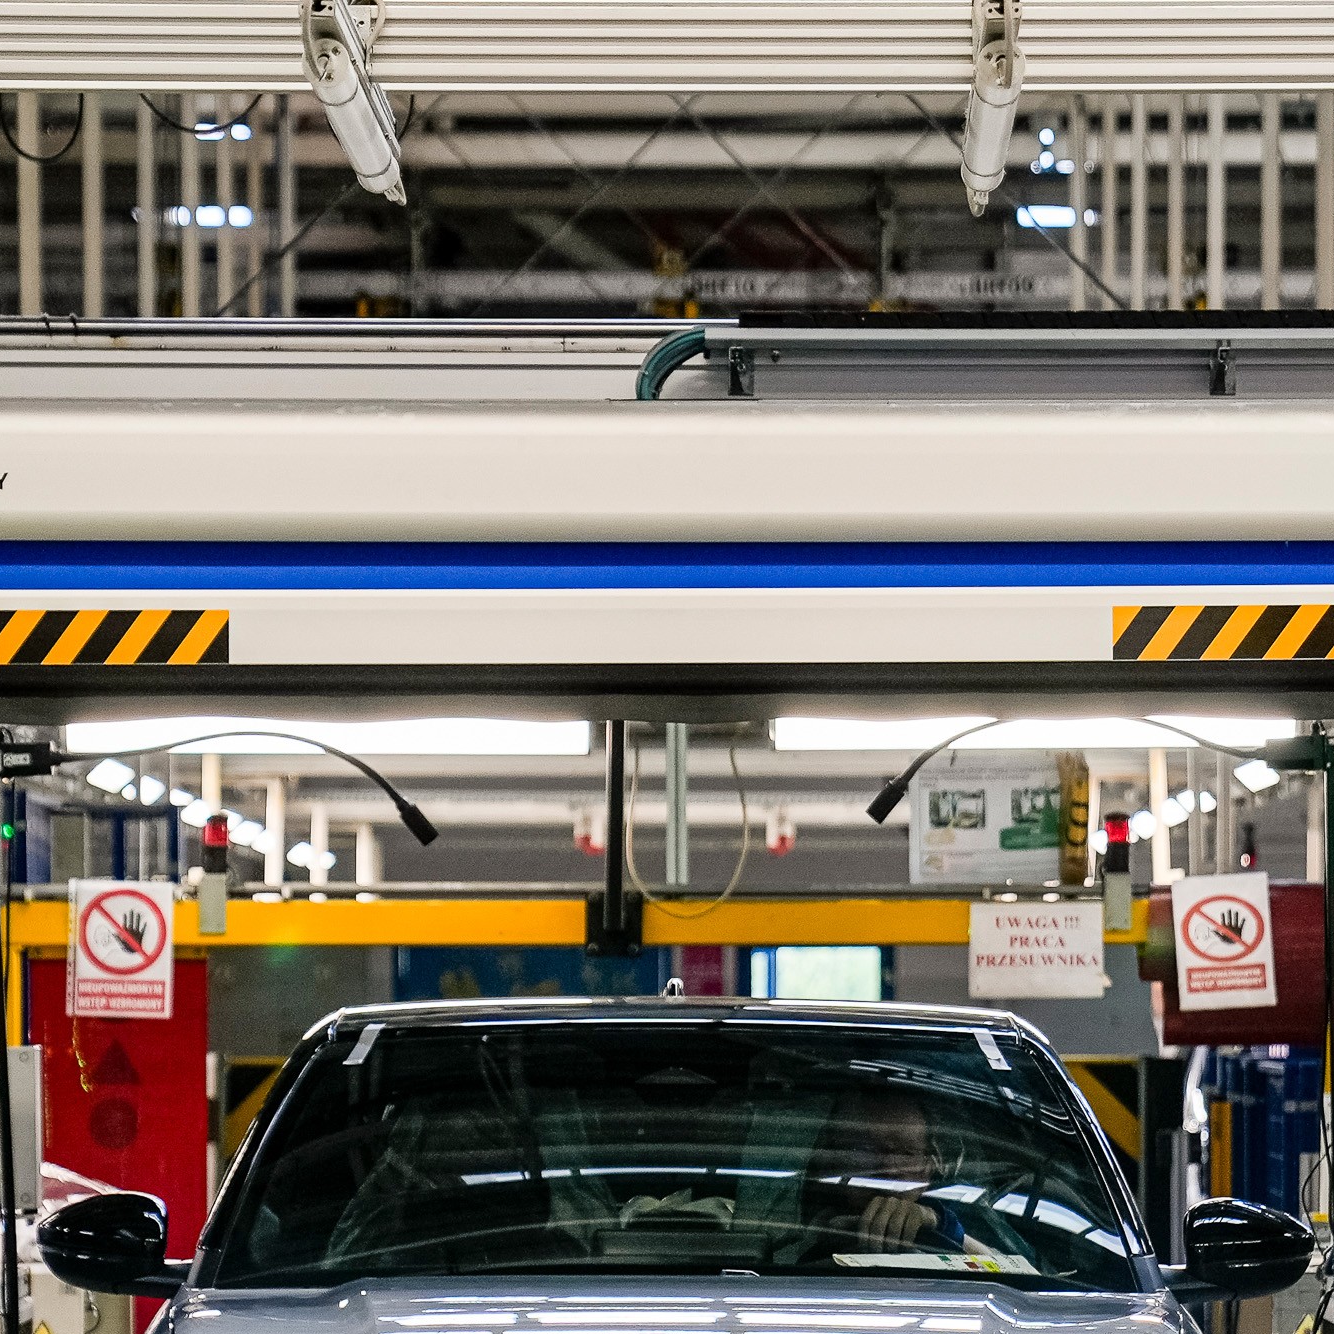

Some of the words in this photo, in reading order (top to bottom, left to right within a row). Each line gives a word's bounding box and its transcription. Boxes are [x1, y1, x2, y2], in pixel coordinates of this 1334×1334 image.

[995, 915, 1059, 930] UWAGA
[1008, 934, 1067, 949] PRACA
[975, 952, 1100, 968] PRZESUWNIKA
